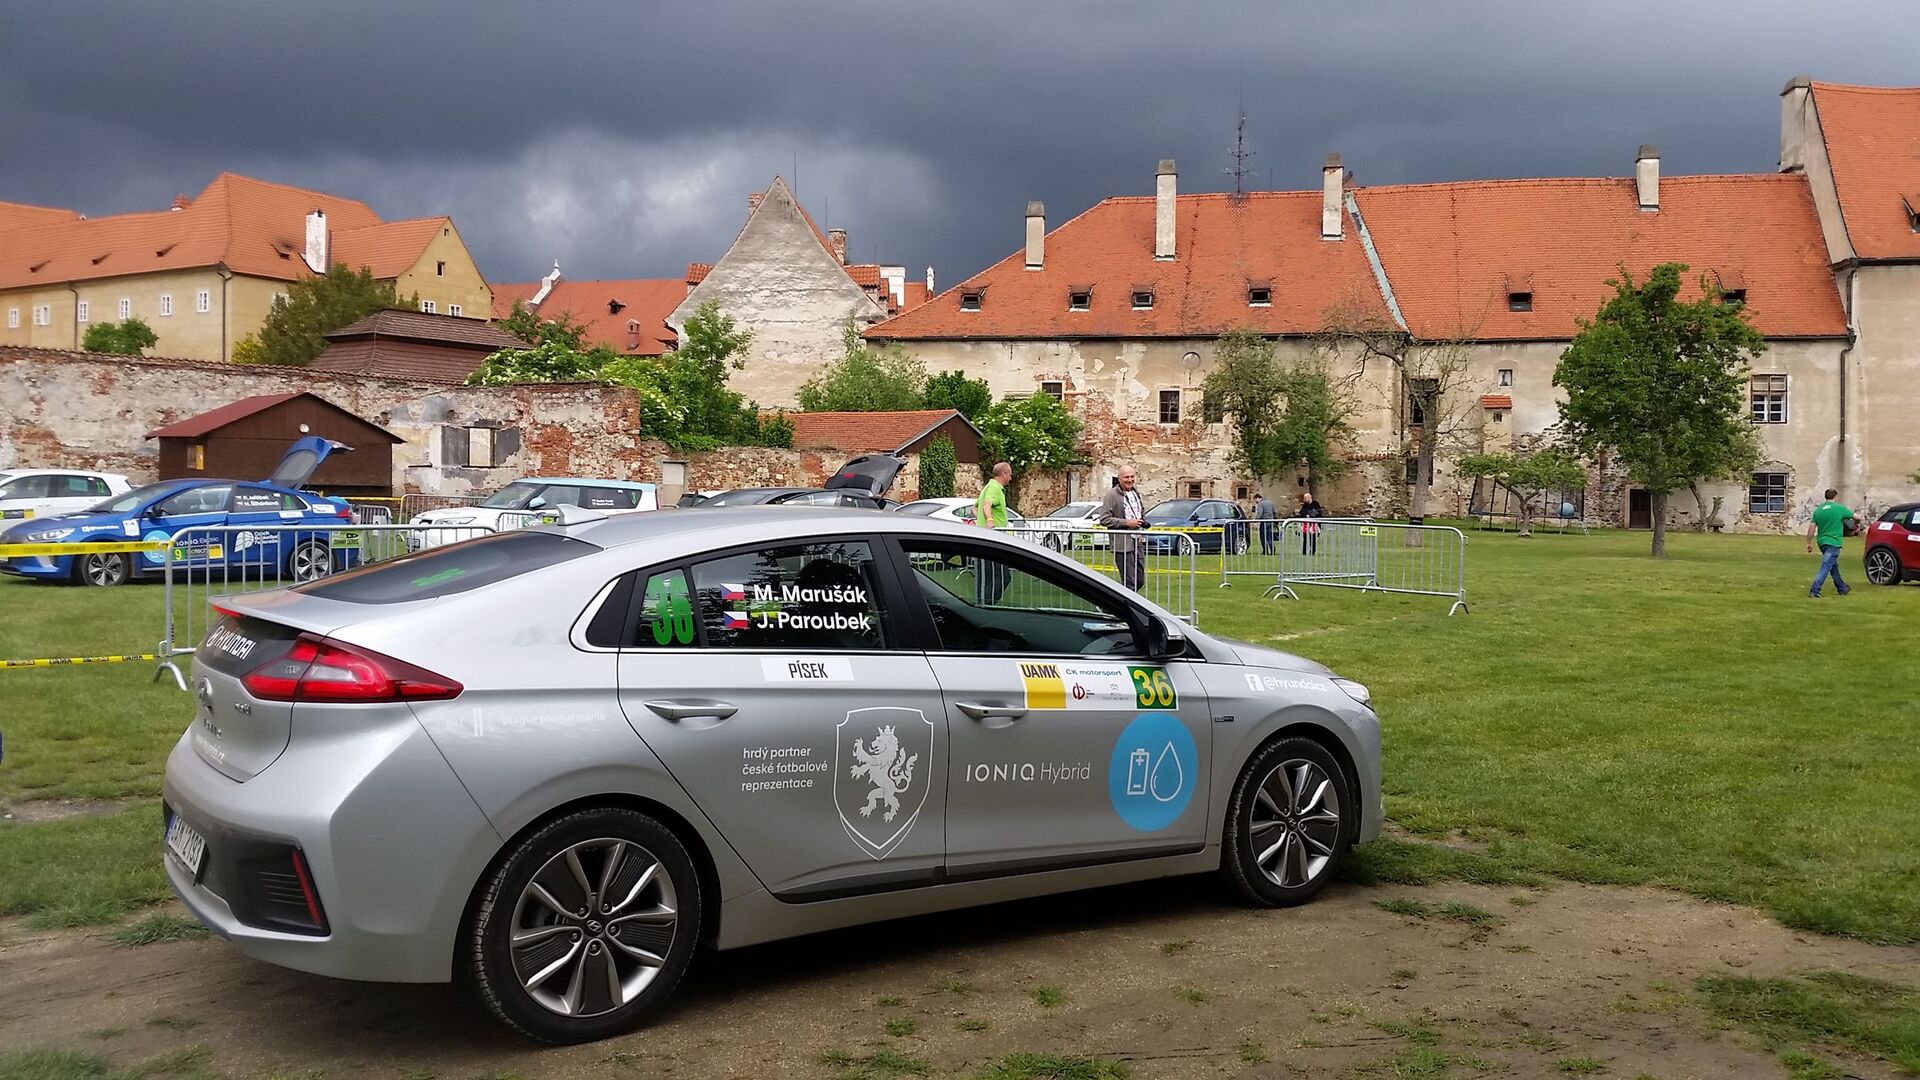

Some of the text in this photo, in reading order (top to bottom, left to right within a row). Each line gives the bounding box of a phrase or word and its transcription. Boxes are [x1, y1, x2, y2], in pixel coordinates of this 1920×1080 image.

[174, 549, 182, 560] 9
[753, 584, 868, 604] M. Marušák
[756, 611, 871, 630] J. Paroubek
[214, 629, 257, 660] HYUNDAI
[788, 659, 828, 678] PÍSEK
[1021, 664, 1060, 679] UAMK
[1133, 669, 1174, 706] 36
[743, 747, 811, 760] hrdý partner
[742, 760, 828, 775] české fotbalové
[966, 762, 1091, 784] IONIQ Hybrid
[741, 778, 814, 792] reprezentace
